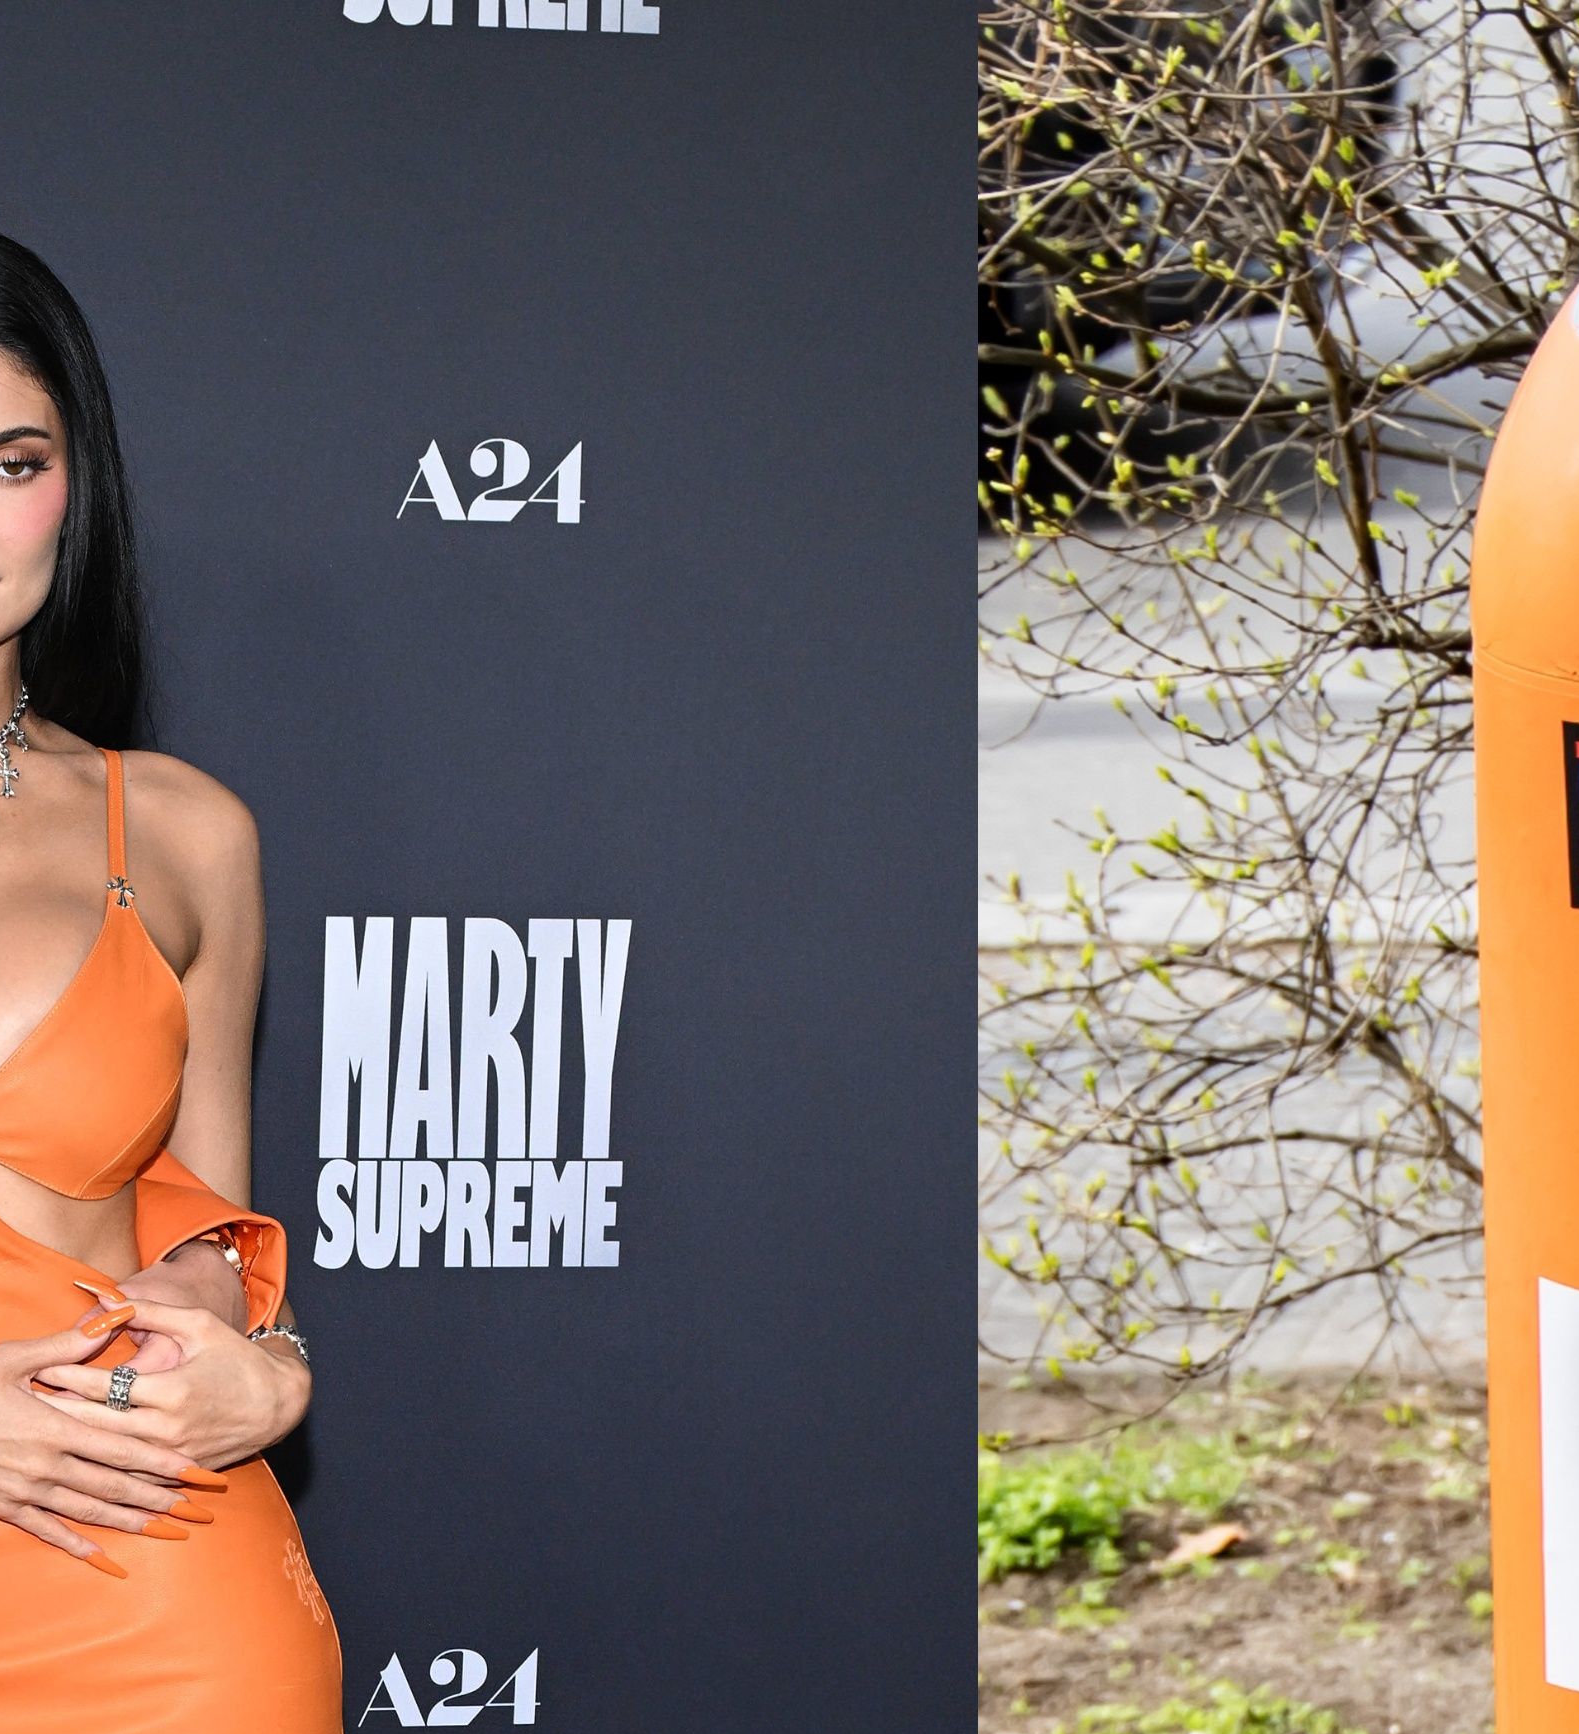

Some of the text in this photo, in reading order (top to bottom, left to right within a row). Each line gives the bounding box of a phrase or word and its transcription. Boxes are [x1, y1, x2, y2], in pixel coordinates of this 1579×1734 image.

[396, 437, 586, 524] A24
[318, 915, 633, 1159] MARTY
[313, 1158, 623, 1270] SUPREME
[357, 1647, 541, 1728] A24
